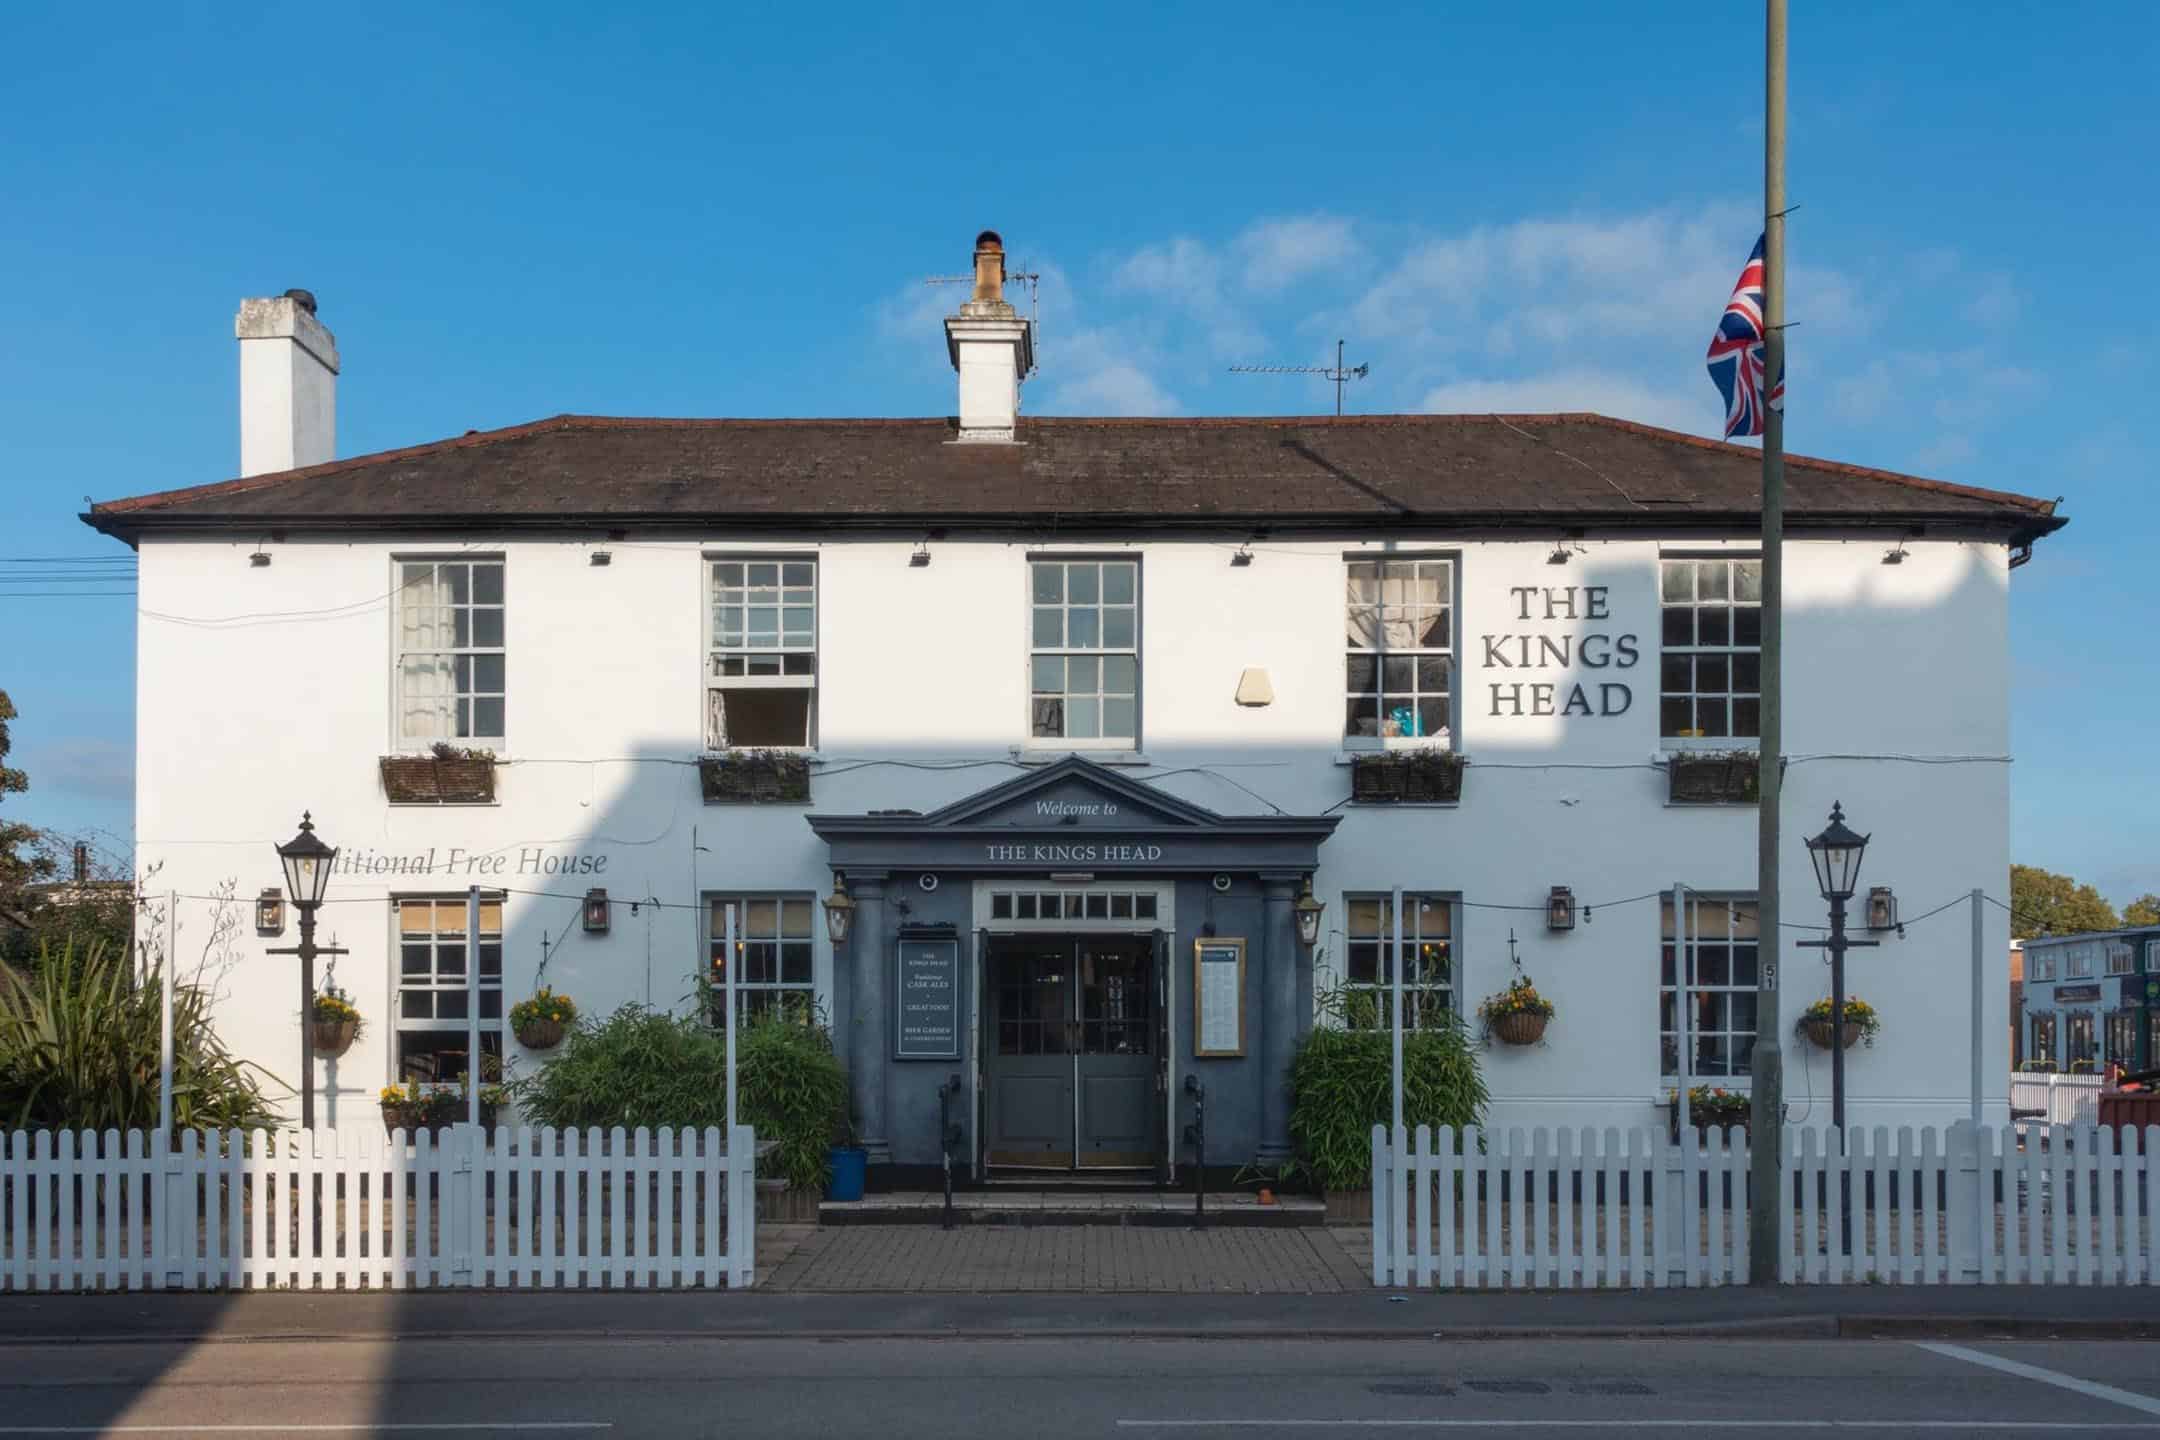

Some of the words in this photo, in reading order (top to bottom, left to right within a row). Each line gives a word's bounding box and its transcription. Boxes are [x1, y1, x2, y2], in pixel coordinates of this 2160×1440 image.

[1510, 586, 1610, 620] THE
[1480, 633, 1640, 669] KINGS
[1487, 683, 1633, 717] HEAD
[1035, 801, 1099, 816] Welcome
[1103, 802, 1117, 816] to
[446, 848, 507, 875] Free
[515, 848, 608, 875] House
[986, 845, 1027, 860] THE
[1034, 845, 1097, 860] KINGS
[1103, 845, 1161, 860] HEAD
